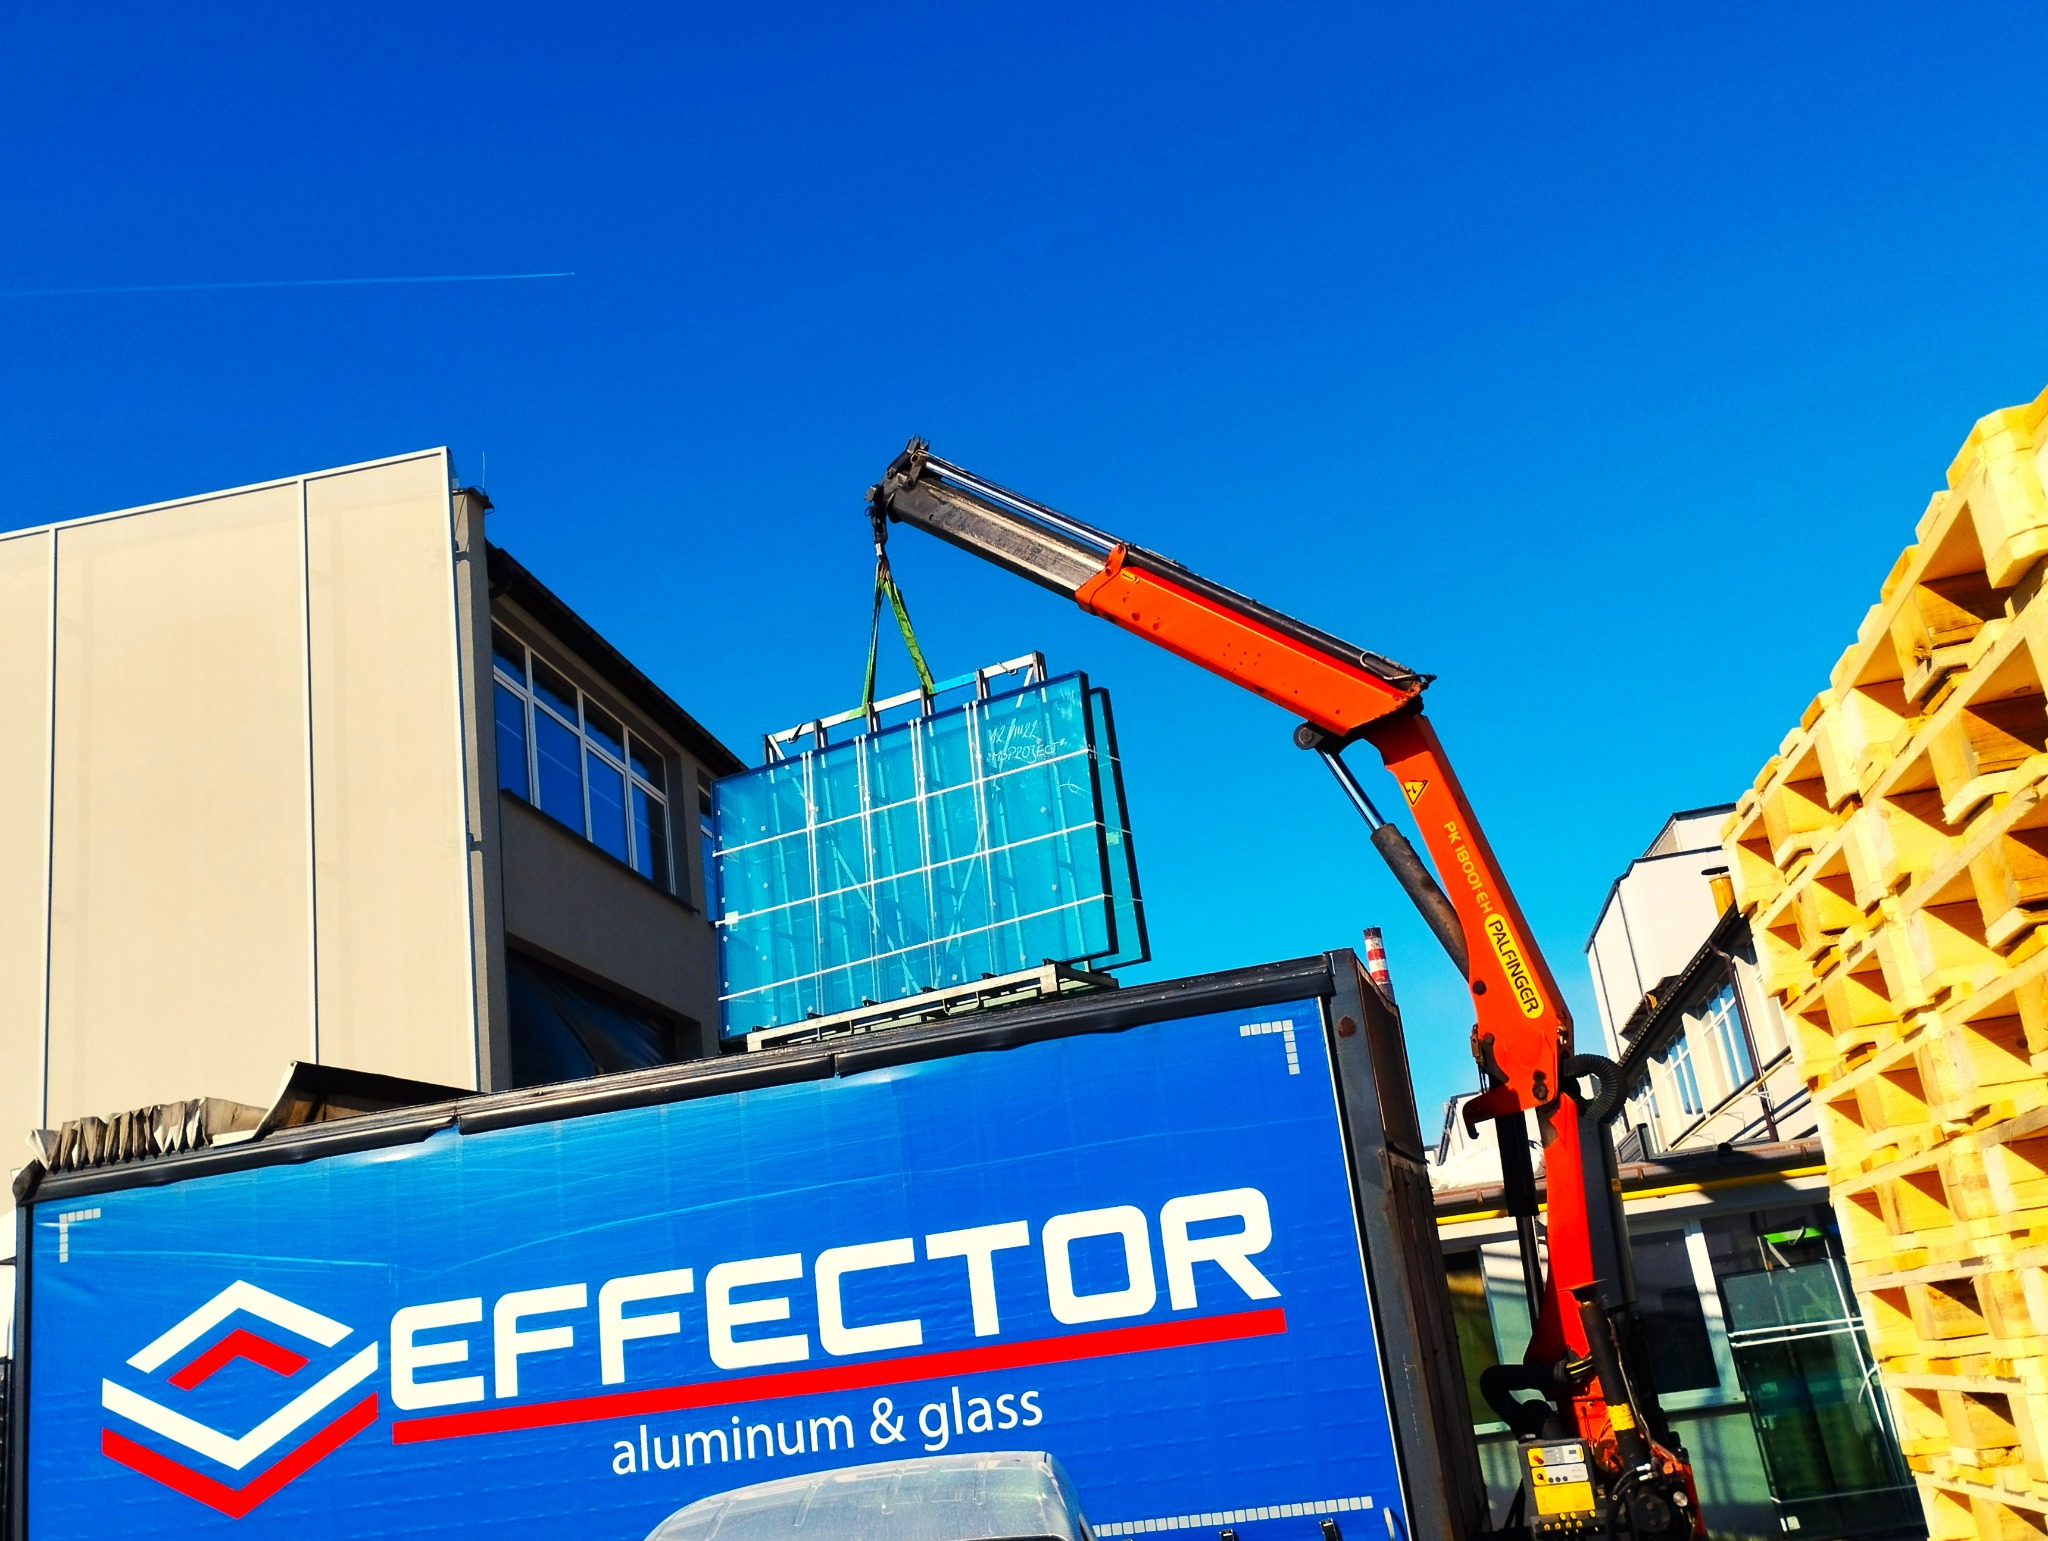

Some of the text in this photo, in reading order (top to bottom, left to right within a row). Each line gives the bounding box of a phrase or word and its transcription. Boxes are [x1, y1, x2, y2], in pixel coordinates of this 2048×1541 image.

[1443, 820, 1462, 845] PK
[1488, 918, 1540, 1014] PALFINGER
[390, 1186, 1282, 1410] EFFECTOR
[611, 1385, 1043, 1476] aluminum & glass
